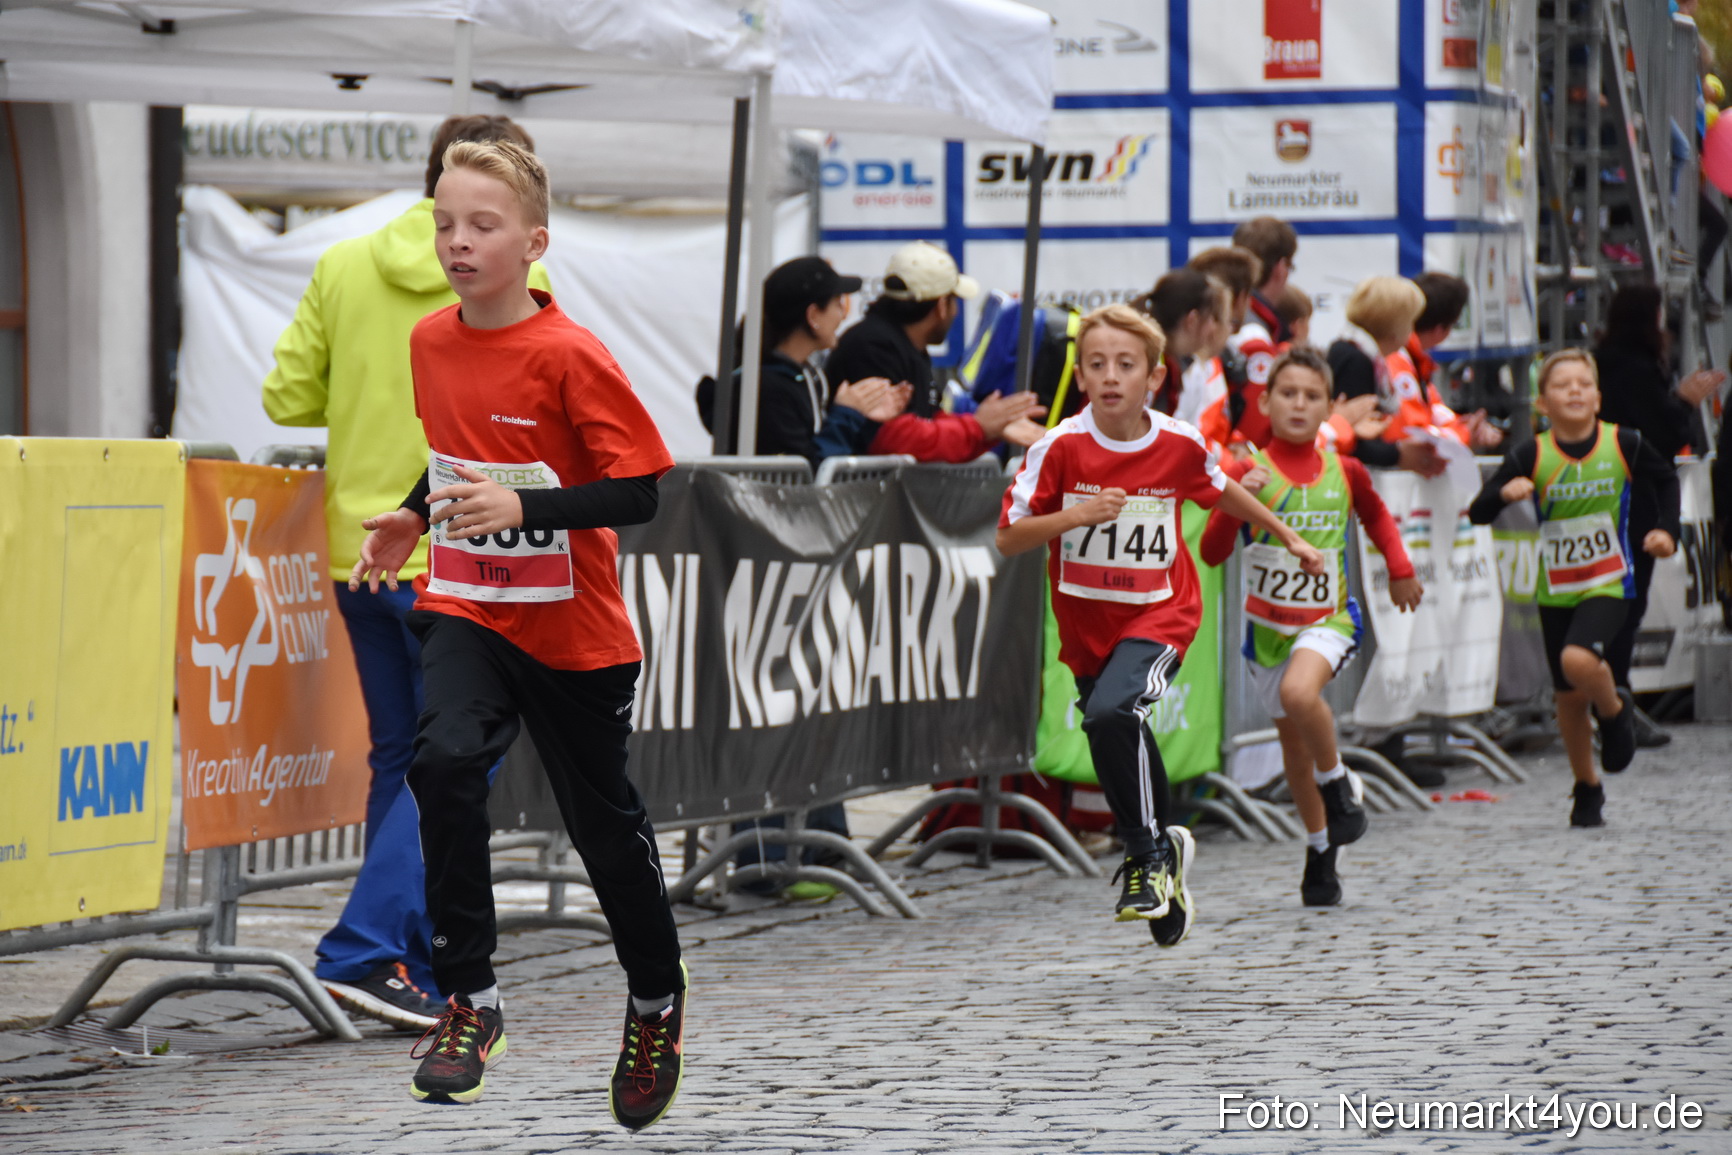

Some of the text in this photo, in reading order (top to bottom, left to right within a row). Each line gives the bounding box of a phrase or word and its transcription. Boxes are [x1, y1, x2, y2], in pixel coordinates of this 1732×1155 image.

[491, 414, 538, 427] FC Holzheim
[1074, 481, 1101, 494] JAKO
[1274, 510, 1340, 531] OCK
[557, 543, 565, 552] K
[1078, 522, 1169, 562] 7144
[1548, 529, 1611, 565] 7239
[268, 552, 323, 605] CODE
[475, 560, 511, 582] Tim
[1103, 571, 1135, 588] Luis
[1252, 564, 1329, 603] 7228
[723, 543, 997, 729] NEUMARKT
[57, 740, 149, 822] KANN
[186, 743, 335, 807] KreativAgentur
